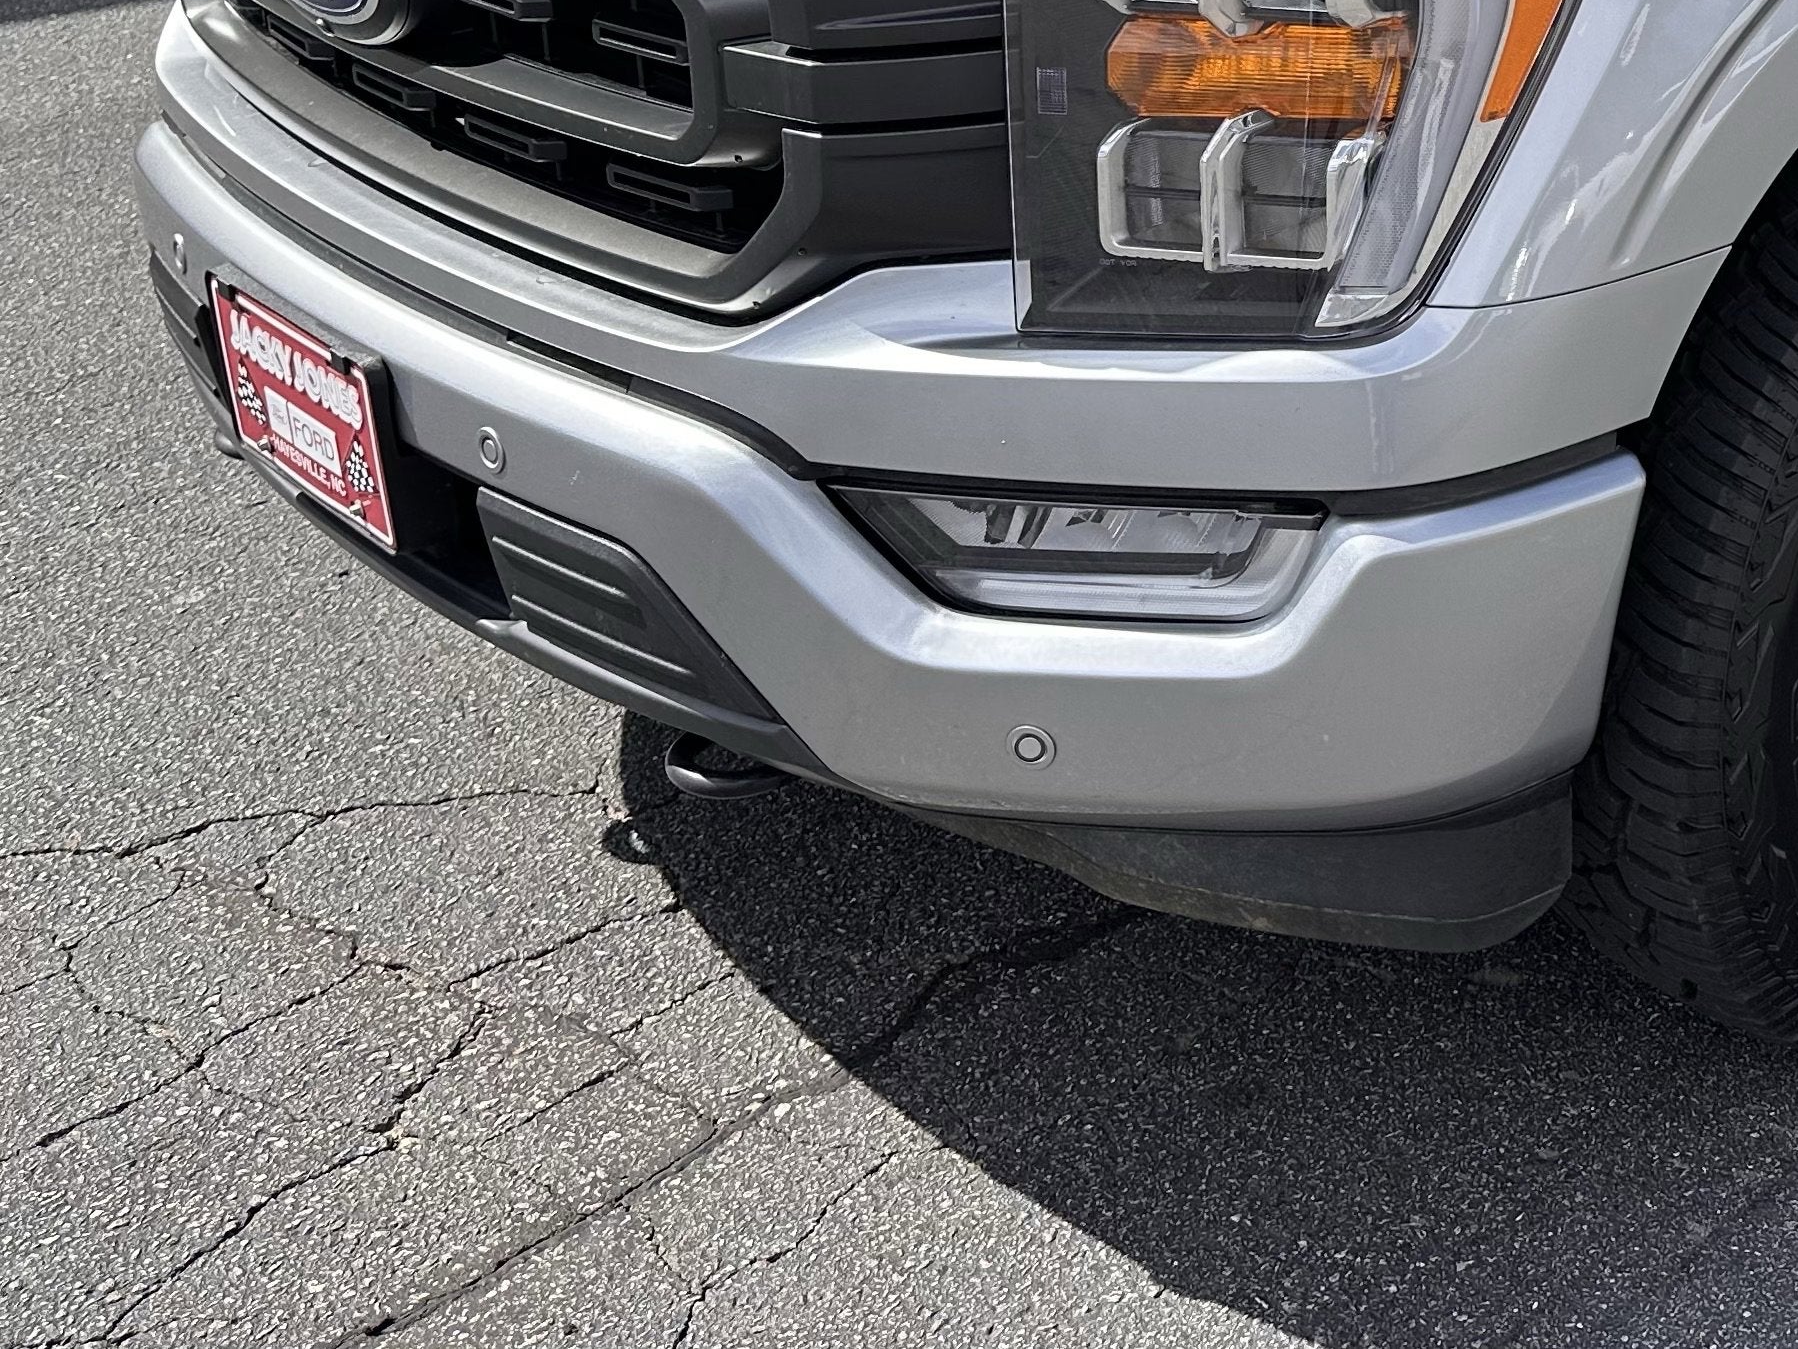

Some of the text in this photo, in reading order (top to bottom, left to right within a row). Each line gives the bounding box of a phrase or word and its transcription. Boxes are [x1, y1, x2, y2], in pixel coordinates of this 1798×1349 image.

[230, 309, 363, 430] JACKY JONES
[293, 417, 335, 461] FORD
[330, 474, 347, 497] NC
